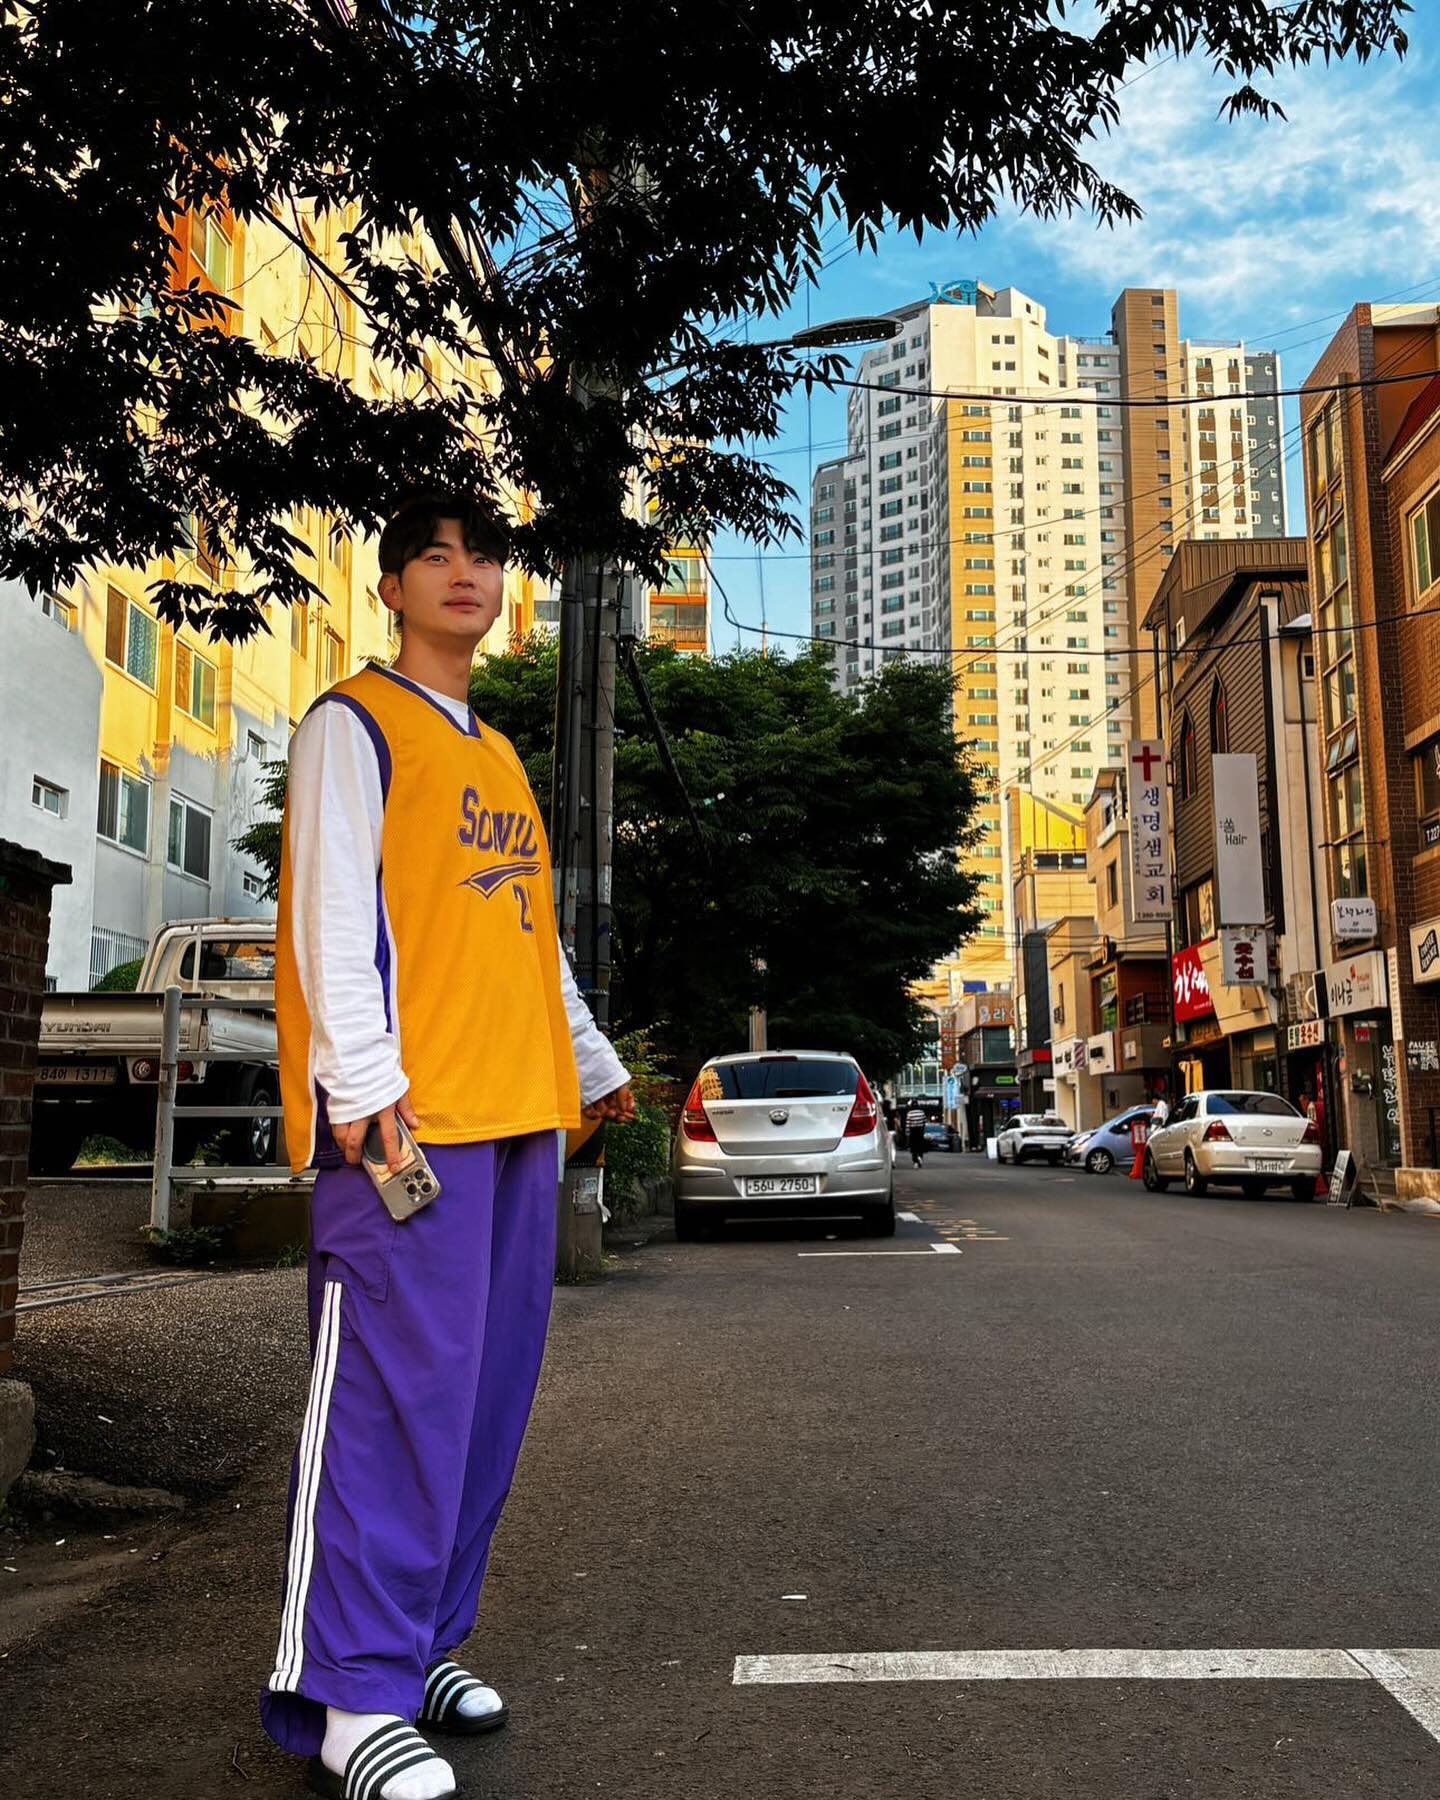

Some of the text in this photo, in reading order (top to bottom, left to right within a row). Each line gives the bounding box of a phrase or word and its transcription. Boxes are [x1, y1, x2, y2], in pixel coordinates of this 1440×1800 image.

[1142, 786, 1166, 906] 생명샘교회
[1225, 833, 1248, 846] Hair
[42, 1022, 112, 1033] YUNDAI
[75, 1067, 108, 1081] 1311
[780, 1178, 810, 1191] 2750
